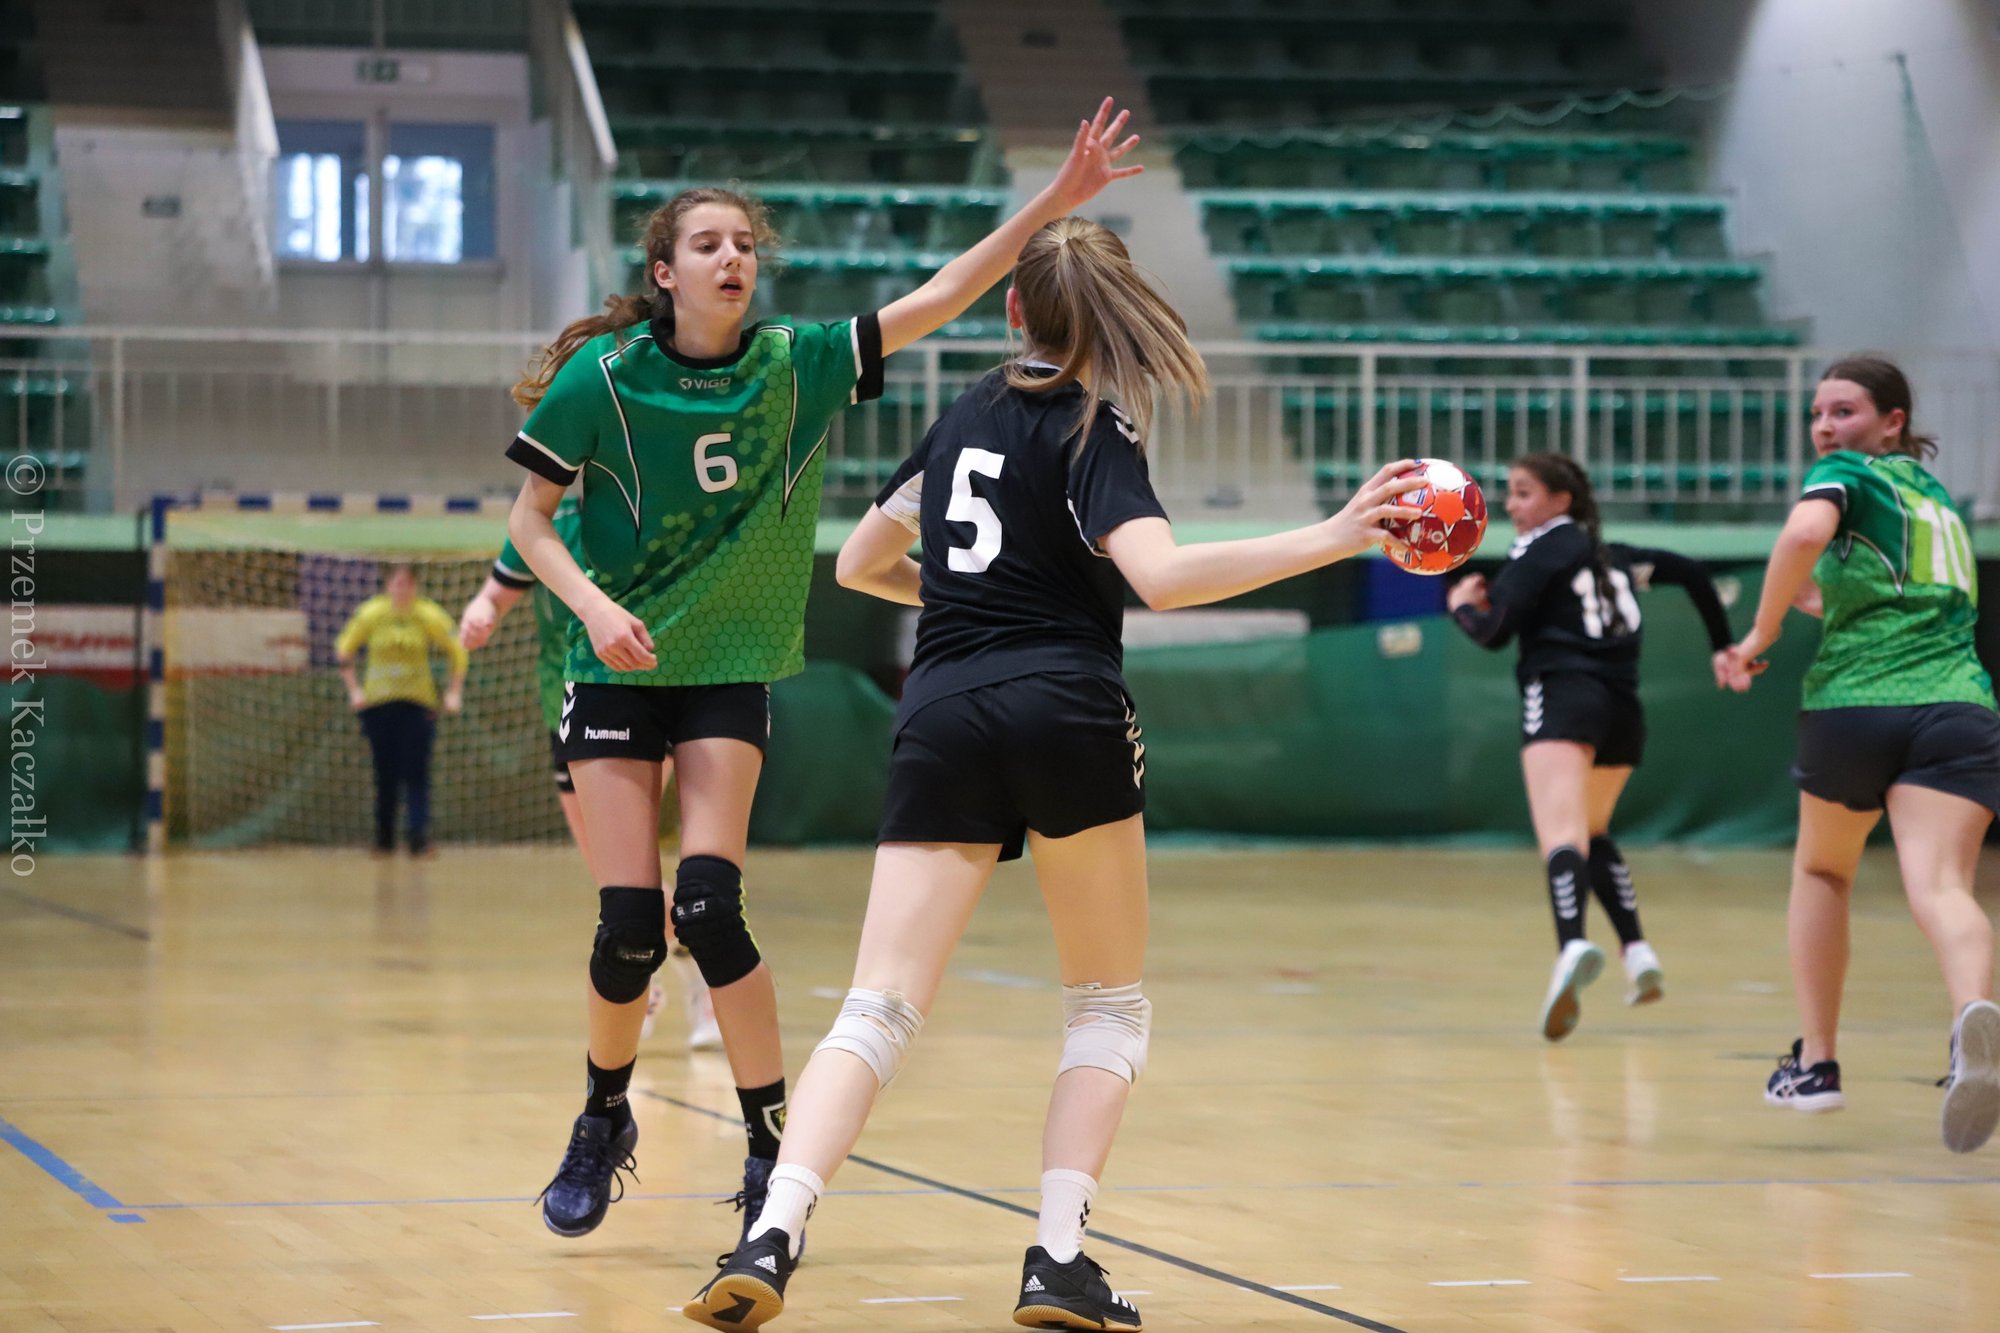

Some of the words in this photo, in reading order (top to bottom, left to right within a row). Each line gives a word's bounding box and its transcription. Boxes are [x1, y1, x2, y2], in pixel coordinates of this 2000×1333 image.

[693, 431, 739, 494] 6
[945, 447, 1006, 574] 5
[1914, 498, 1972, 593] 10
[584, 725, 630, 741] hummel
